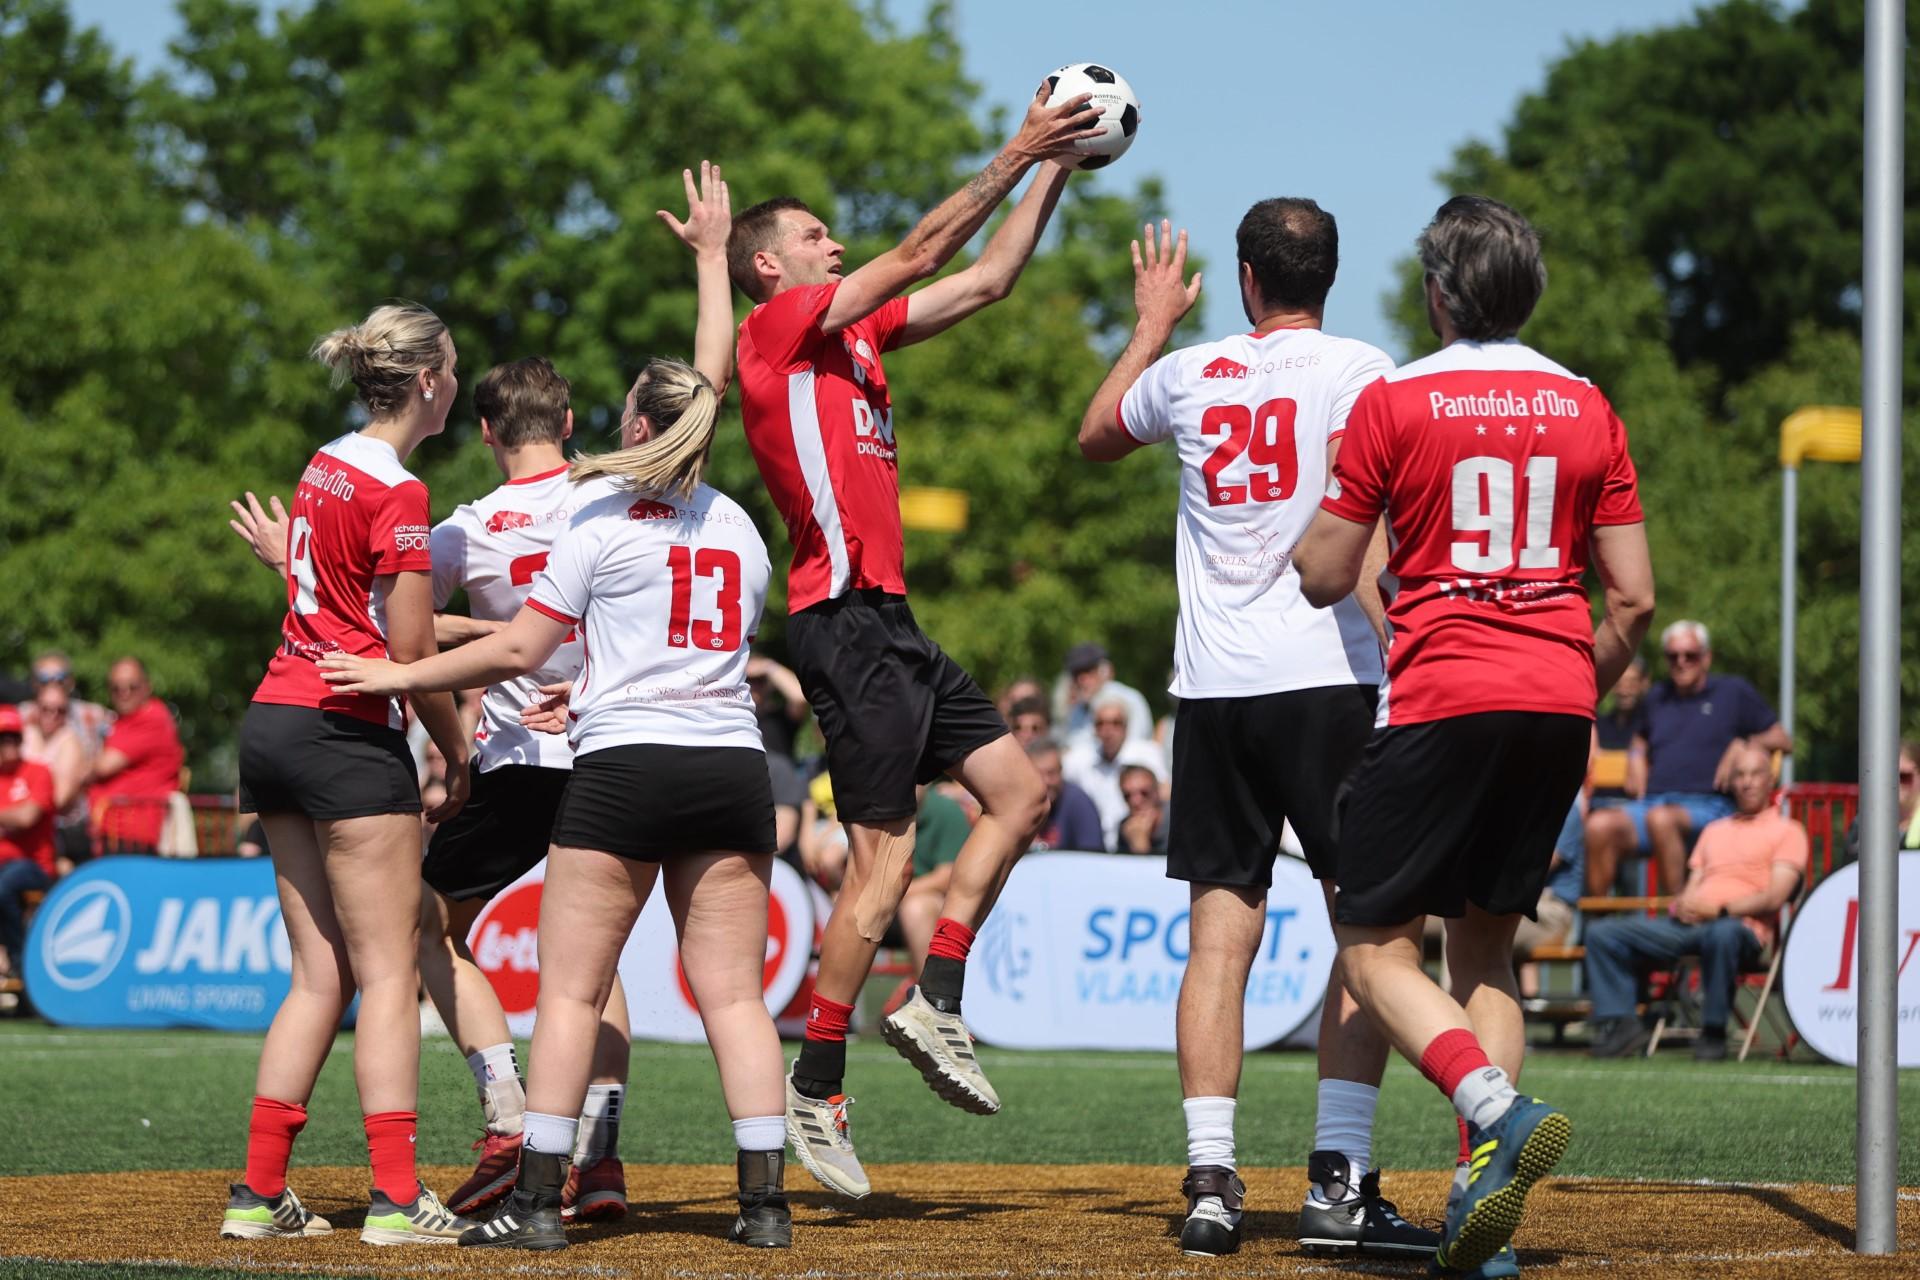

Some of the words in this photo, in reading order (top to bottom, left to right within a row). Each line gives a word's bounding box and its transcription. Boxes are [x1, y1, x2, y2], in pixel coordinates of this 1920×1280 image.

[1429, 390, 1530, 419] Pantofola
[1532, 389, 1580, 418] d'Oro
[1201, 397, 1298, 507] 29
[1451, 456, 1561, 574] 91
[666, 545, 742, 652] 13
[1083, 908, 1310, 961] SPOT.
[193, 985, 265, 1013] SPORTS
